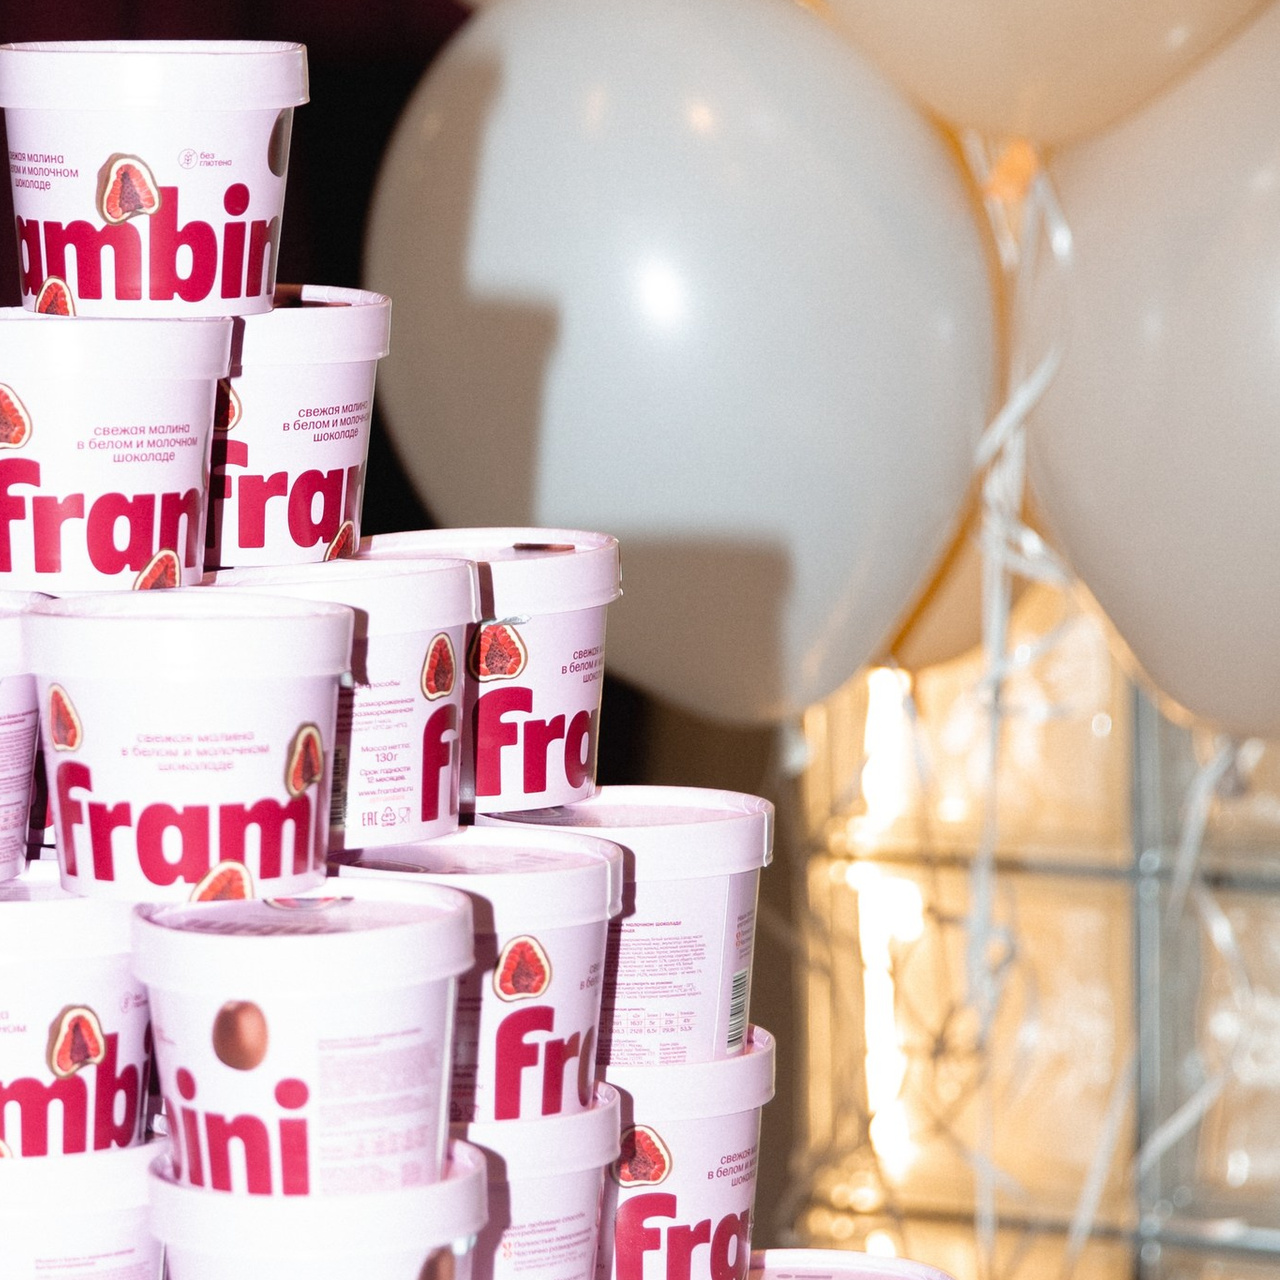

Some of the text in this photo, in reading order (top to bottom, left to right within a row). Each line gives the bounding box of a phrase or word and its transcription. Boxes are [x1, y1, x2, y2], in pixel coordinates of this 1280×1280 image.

[27, 152, 64, 164] малина
[27, 167, 79, 178] молочном
[298, 406, 340, 418] свежая
[93, 424, 191, 437] свежая малина
[282, 419, 338, 431] в белом и
[313, 427, 359, 442] шоколаде
[76, 436, 198, 450] в белом и молочном
[113, 451, 176, 463] шоколаде
[561, 660, 594, 675] в белом
[57, 759, 326, 886] fram
[167, 1066, 310, 1197] ini
[707, 1163, 744, 1180] в белом
